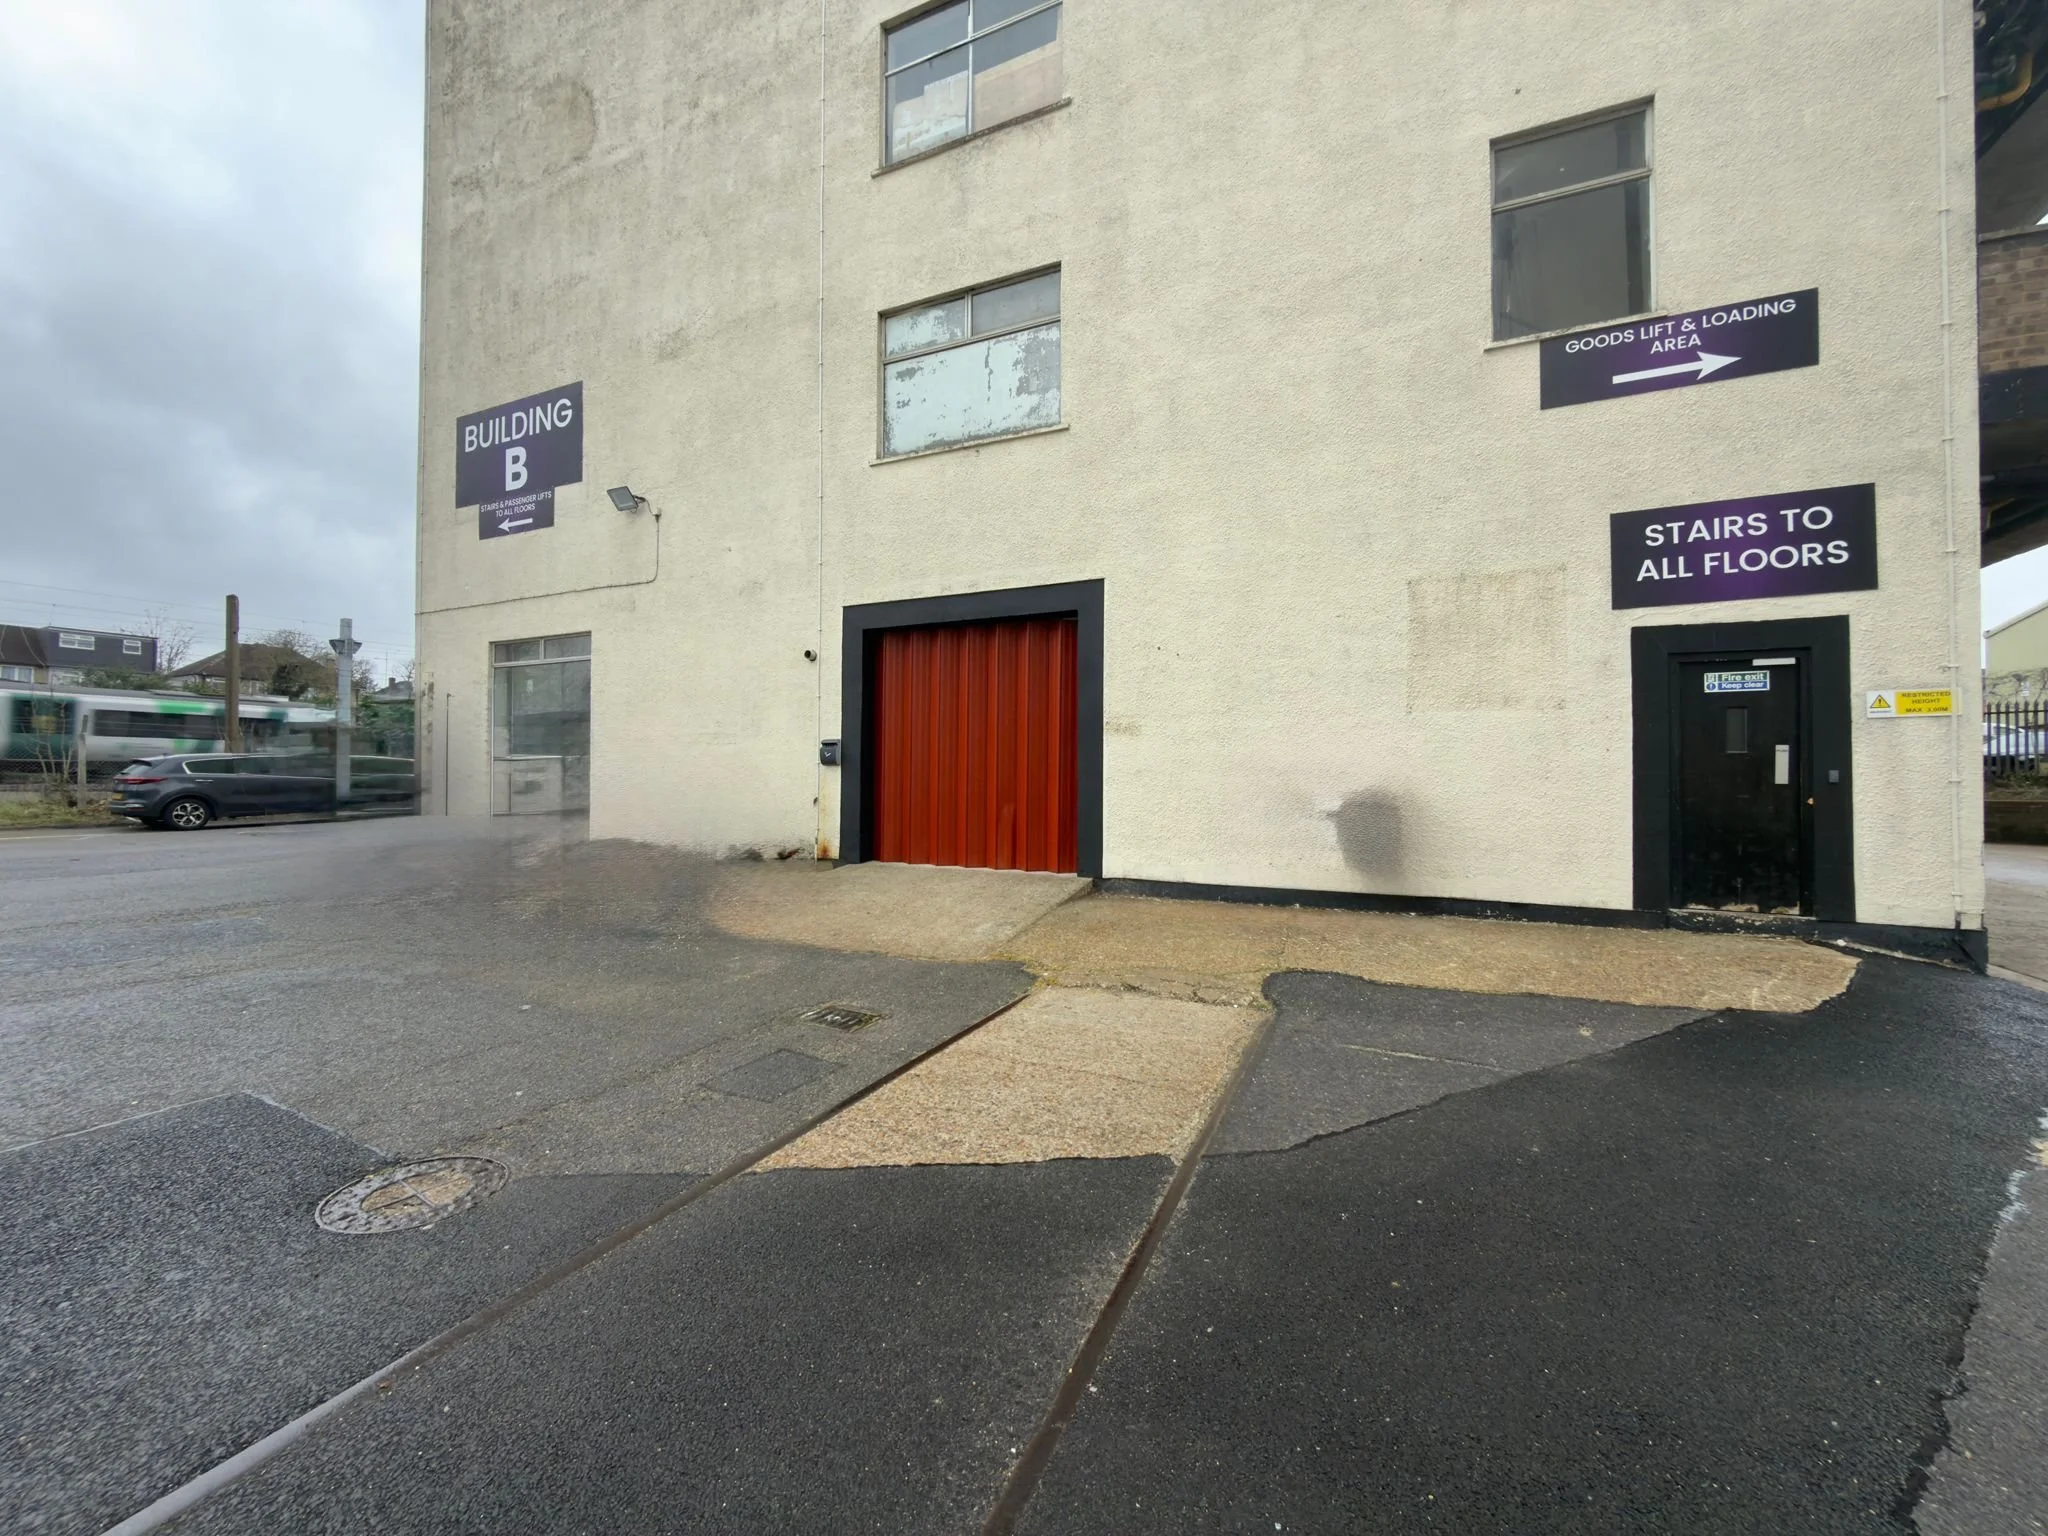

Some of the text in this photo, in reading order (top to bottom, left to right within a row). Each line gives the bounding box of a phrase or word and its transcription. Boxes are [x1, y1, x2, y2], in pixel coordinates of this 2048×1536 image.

[1565, 298, 1796, 353] GOODS LIFT & LOADING
[1650, 334, 1701, 354] AREA
[465, 398, 572, 452] BUILDING
[505, 446, 528, 492] B
[480, 502, 499, 512] STAIRS
[505, 494, 536, 507] PASSENGER
[538, 491, 552, 500] LIFTS
[514, 503, 536, 513] FLOORS
[1645, 506, 1833, 546] STAIRS TO
[1636, 540, 1850, 582] ALL FLOORS
[1744, 672, 1764, 680] exit
